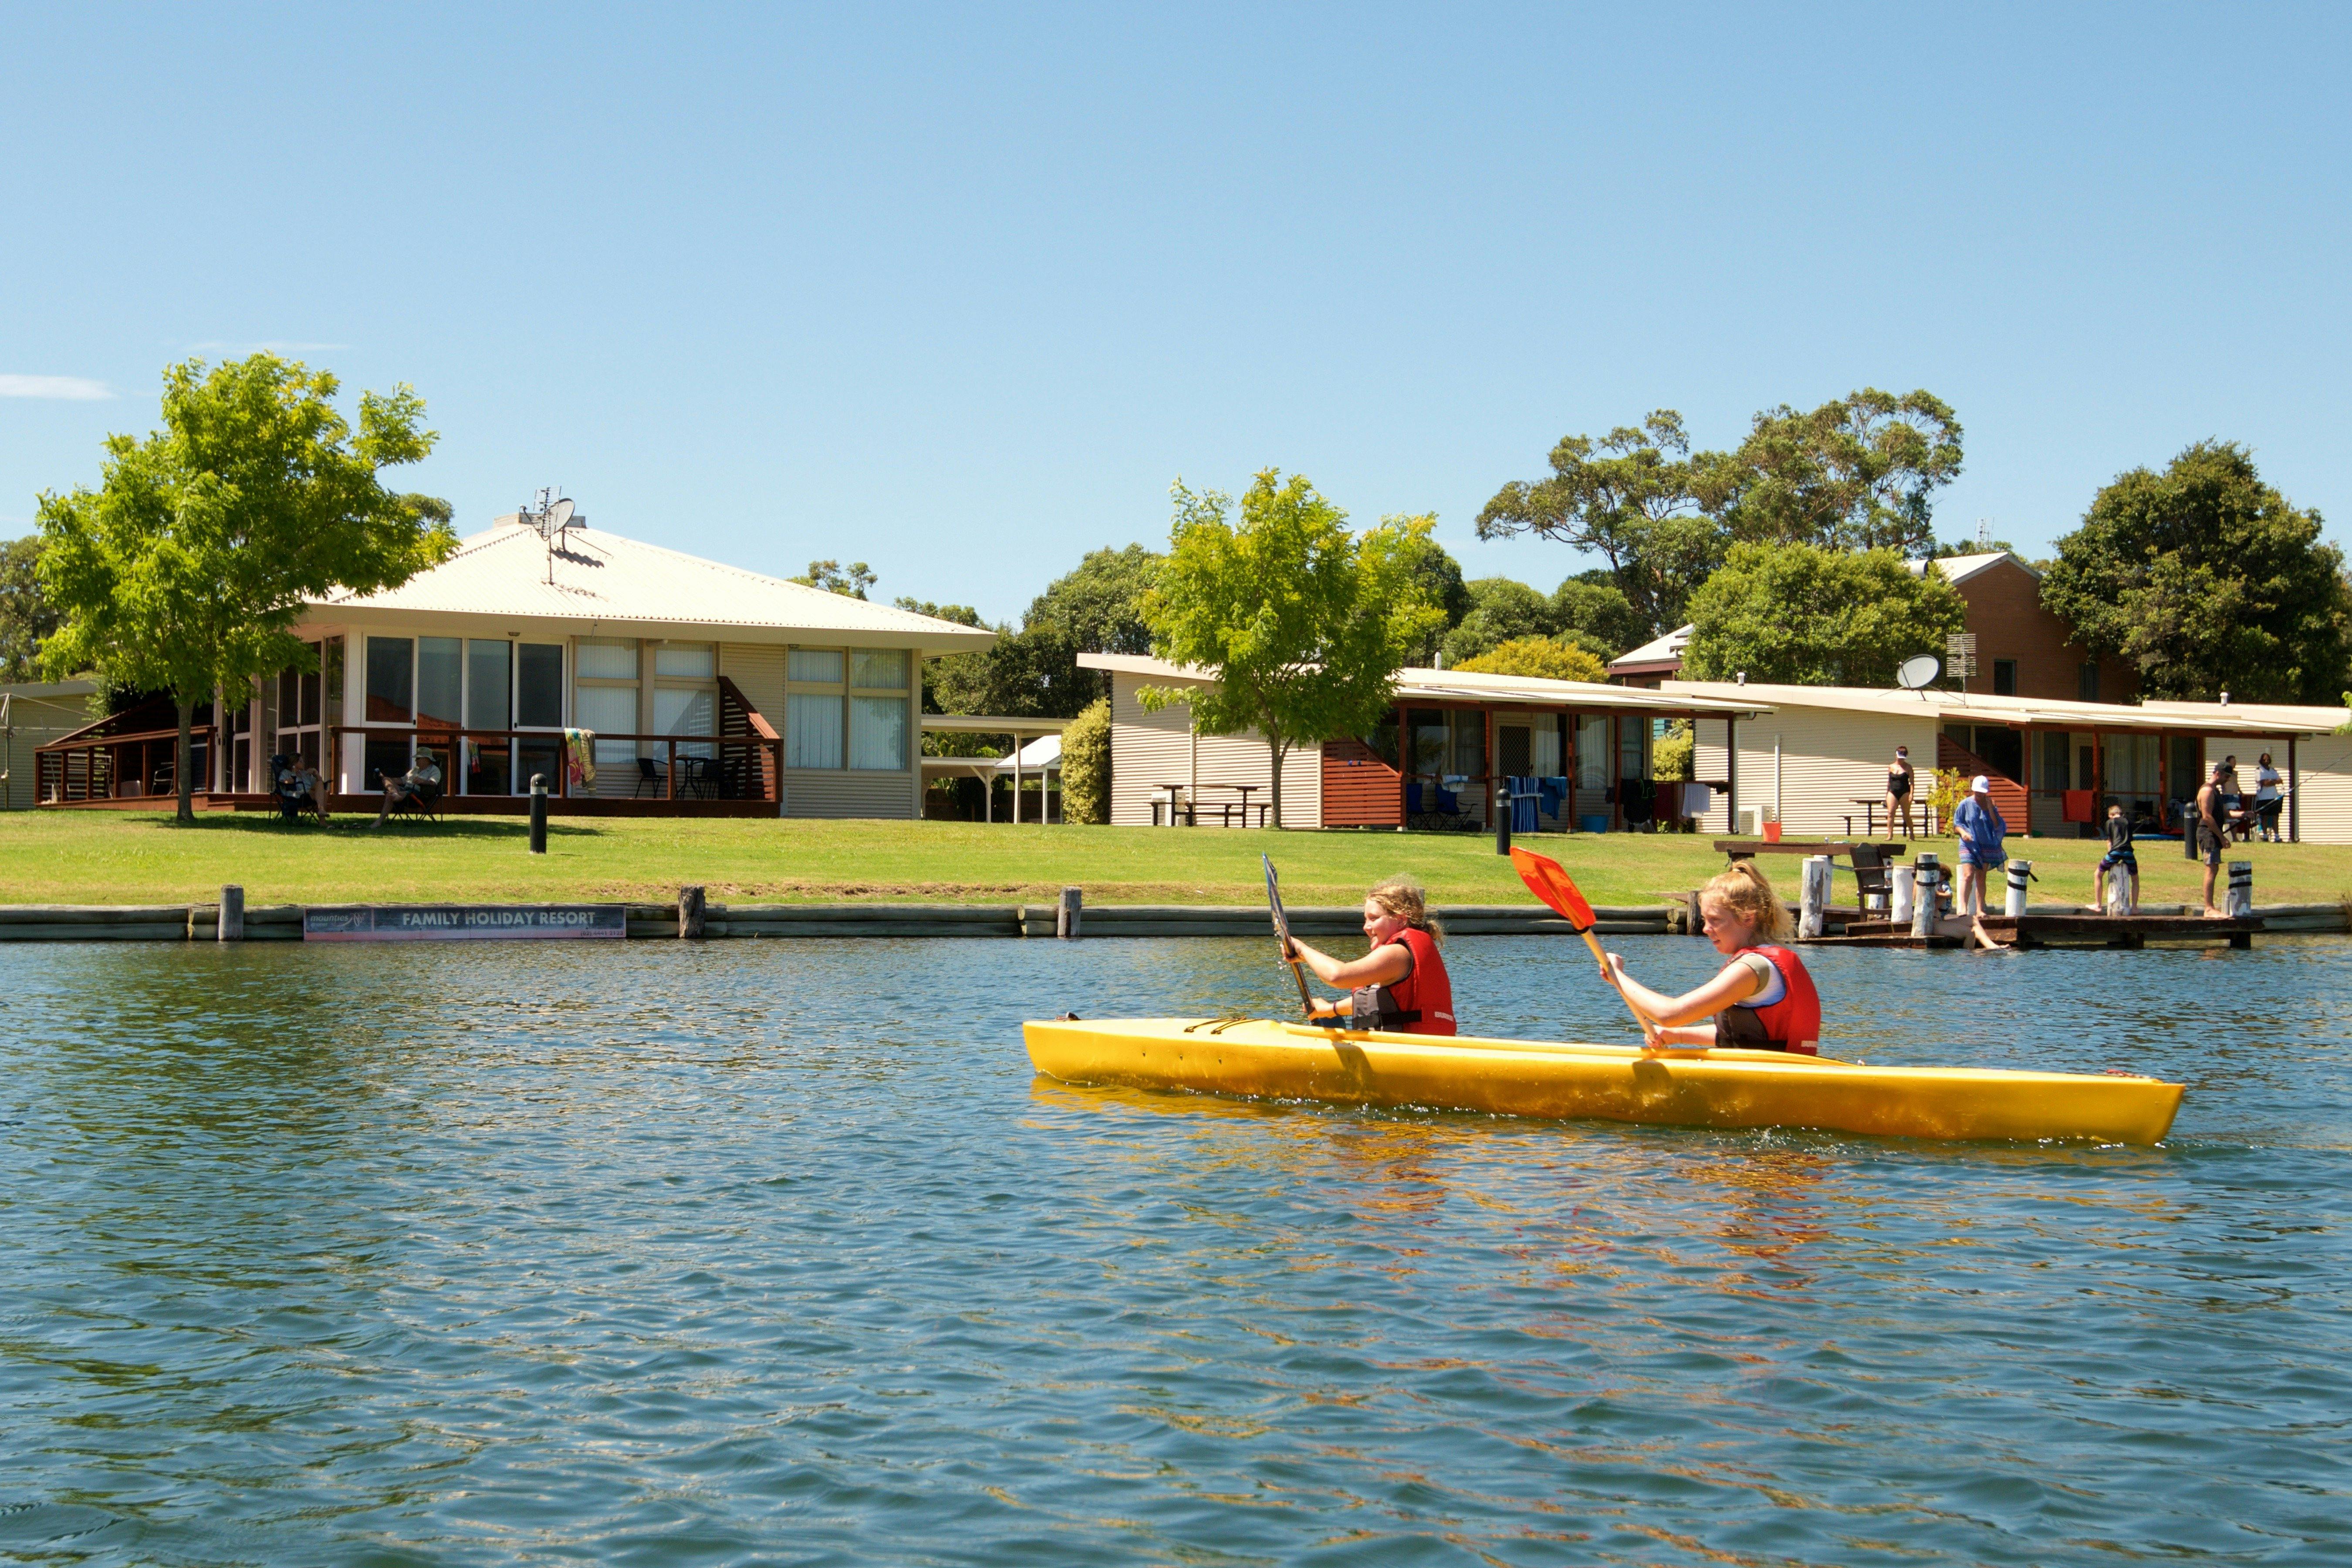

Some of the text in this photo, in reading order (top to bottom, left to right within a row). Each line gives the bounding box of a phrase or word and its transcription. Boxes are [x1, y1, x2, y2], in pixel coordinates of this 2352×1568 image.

[402, 912, 595, 925] FAMILY HOLIDAY RESORT
